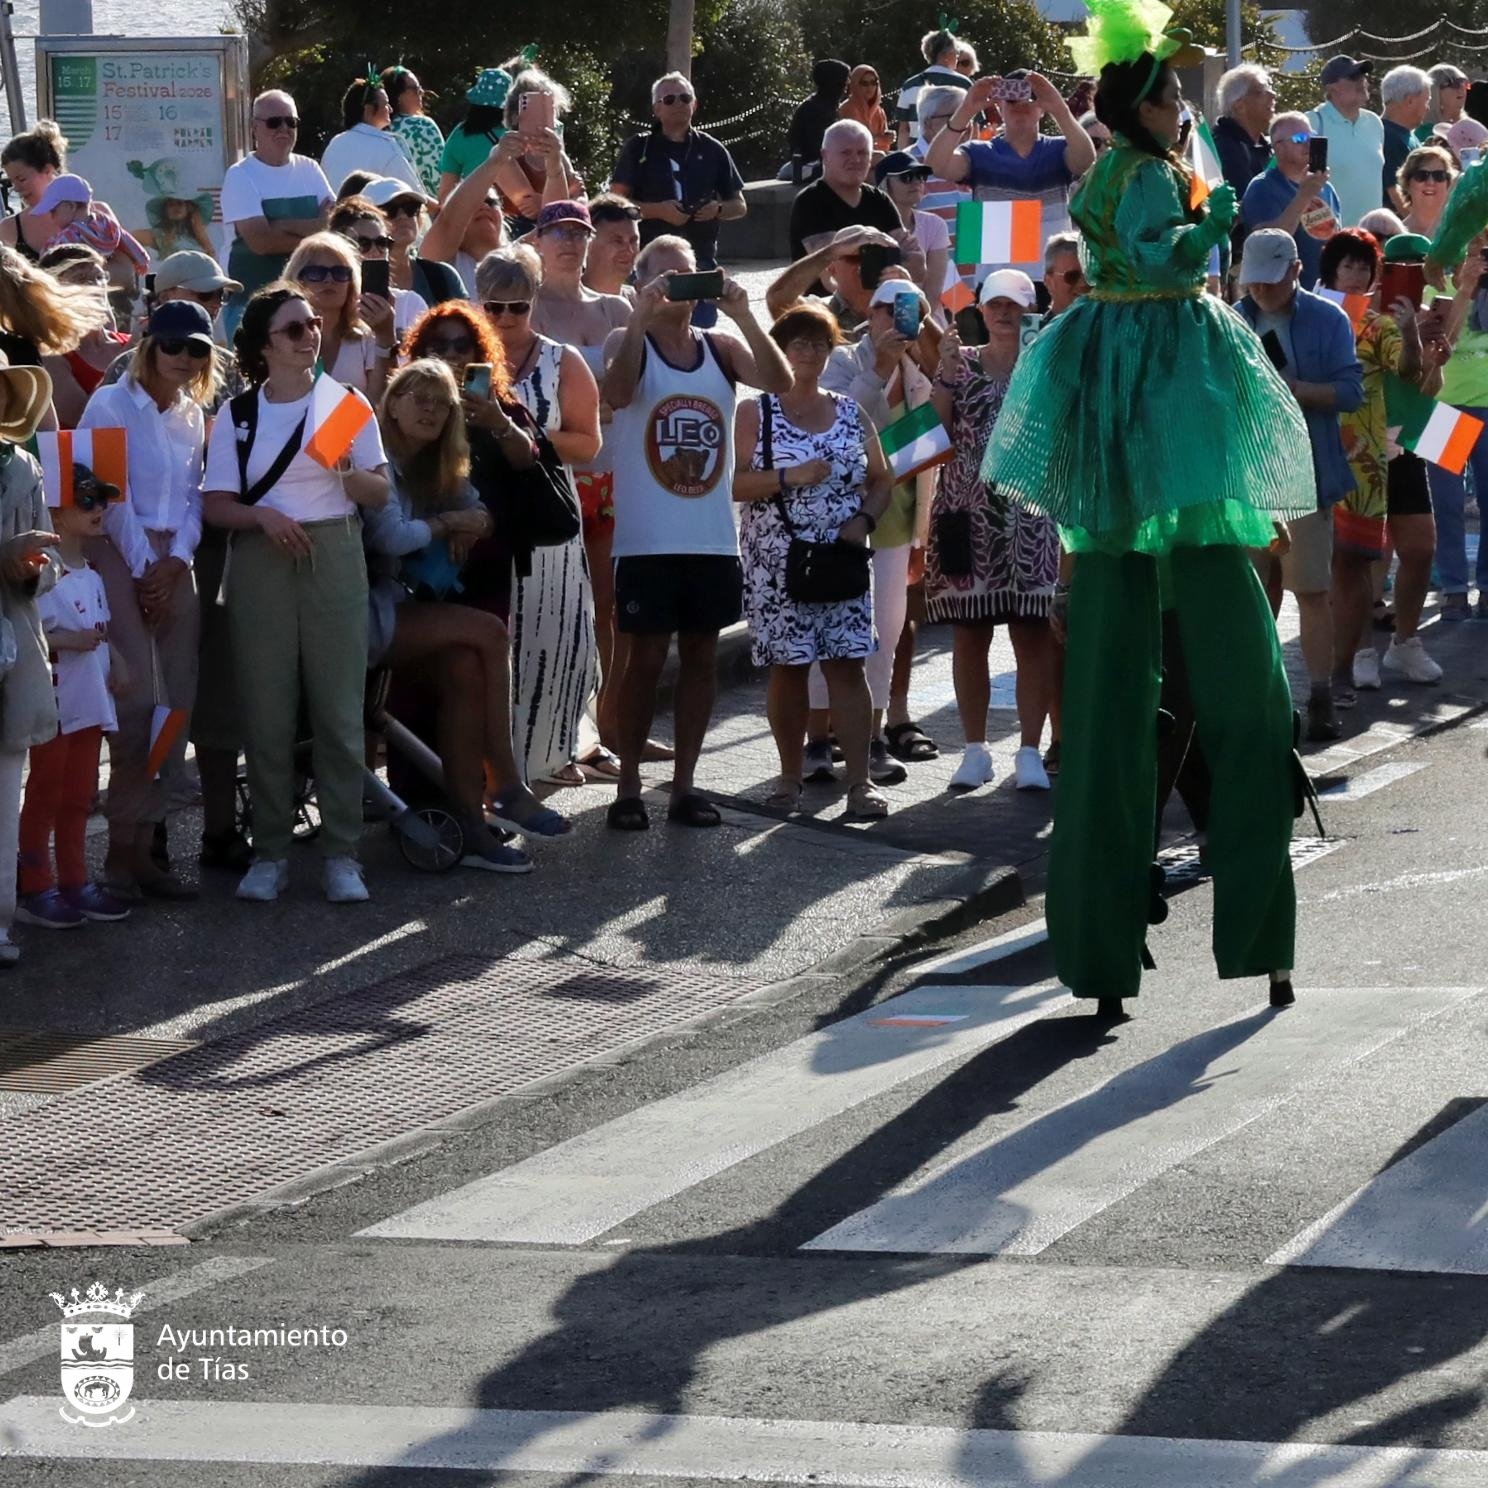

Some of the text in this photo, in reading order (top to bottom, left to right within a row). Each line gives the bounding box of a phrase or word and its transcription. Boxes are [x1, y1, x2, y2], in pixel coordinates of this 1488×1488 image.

[103, 81, 176, 99] Festival
[104, 105, 122, 120] 15
[159, 105, 178, 121] 16
[104, 126, 122, 141] 17
[656, 418, 720, 447] LEO
